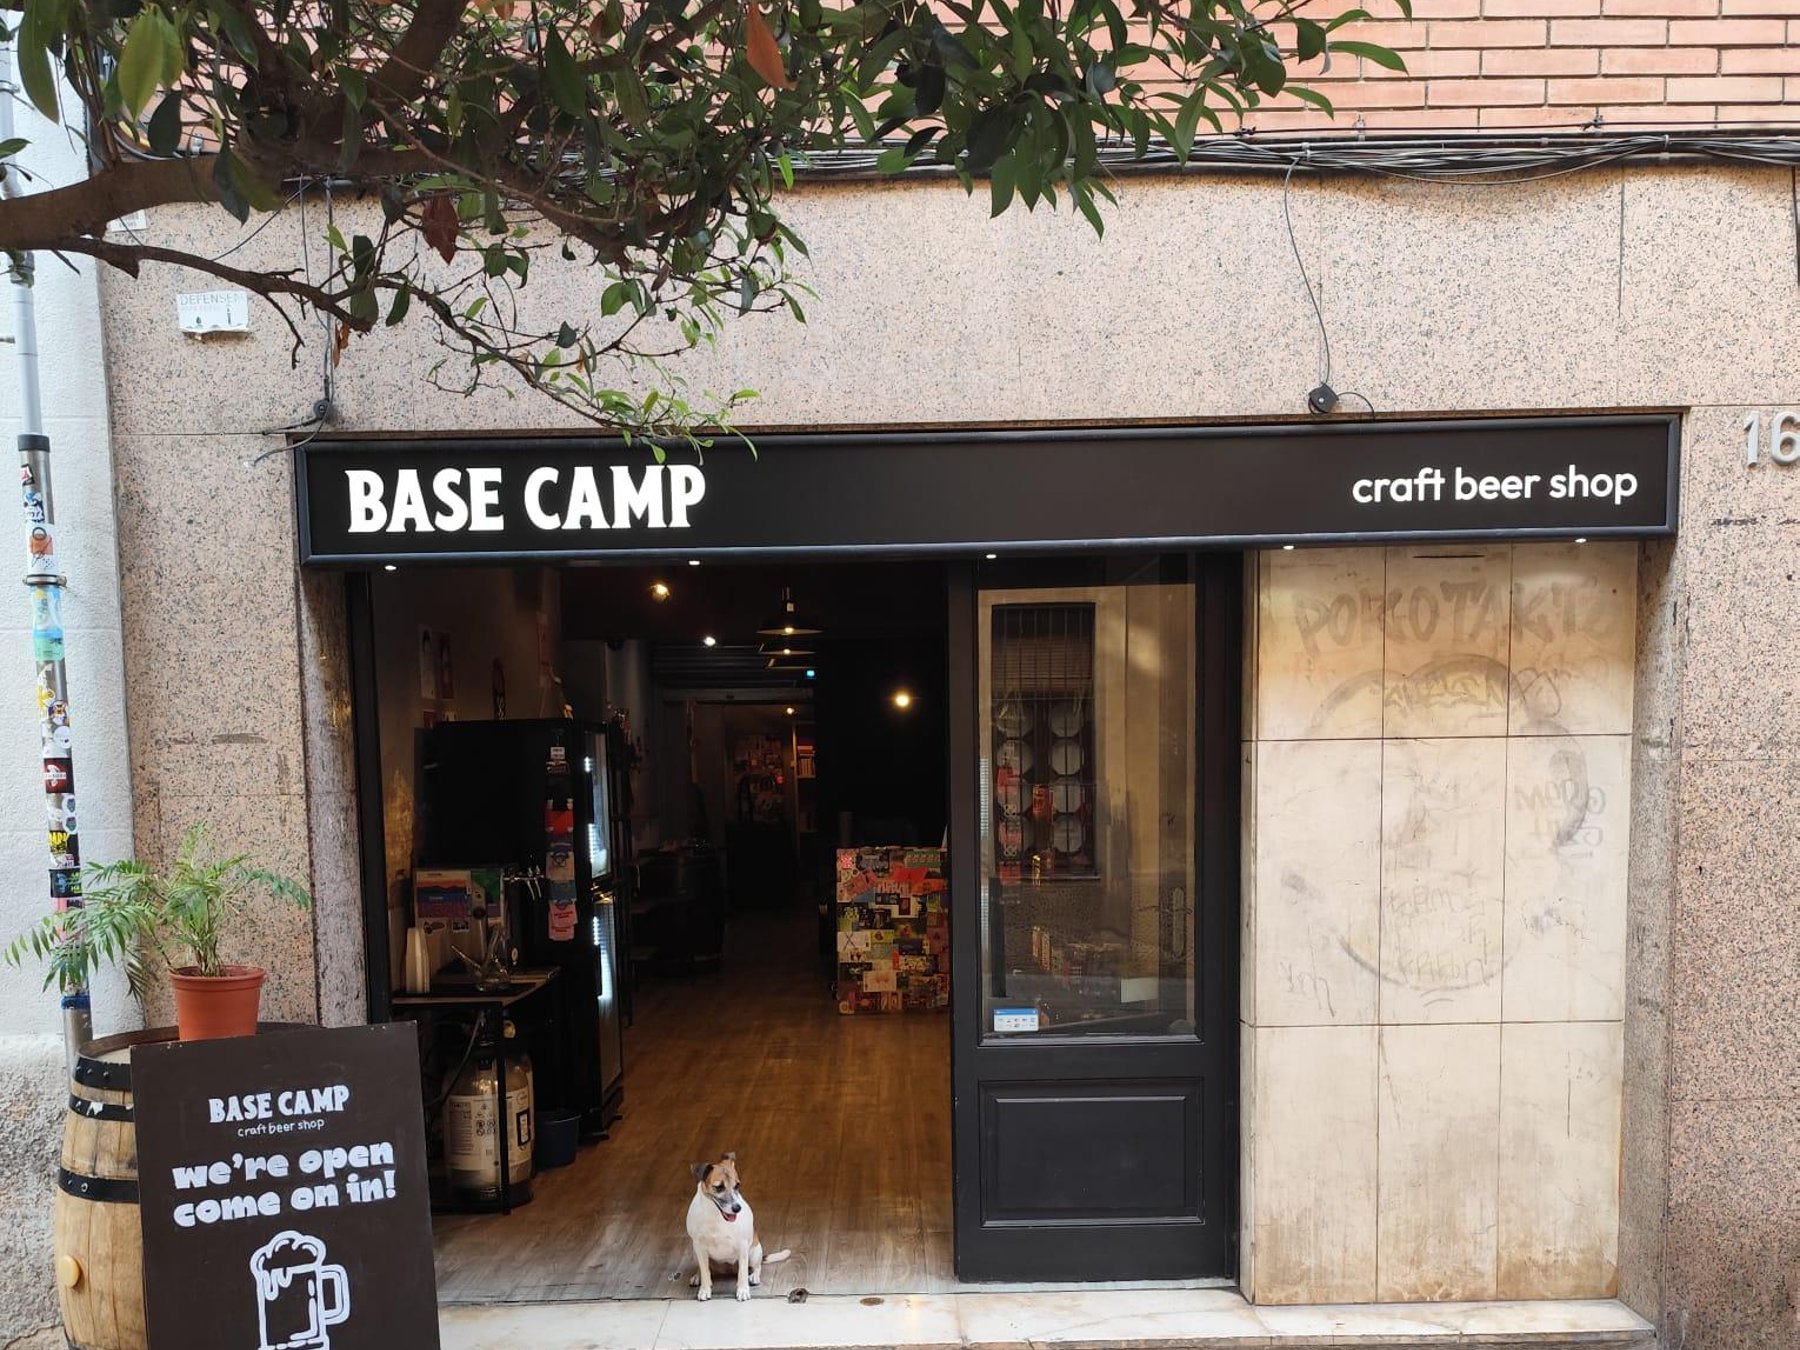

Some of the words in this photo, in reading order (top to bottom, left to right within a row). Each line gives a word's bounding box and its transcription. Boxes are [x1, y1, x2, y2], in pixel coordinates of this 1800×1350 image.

[1743, 410, 1800, 464] 16
[345, 468, 504, 533] BASE
[524, 464, 706, 530] CAMP
[1352, 467, 1445, 503] craft
[1455, 466, 1541, 501] beer
[1549, 464, 1638, 505] shop
[208, 1093, 273, 1123] BASE
[278, 1085, 350, 1116] CAMP
[237, 1123, 267, 1137] craft
[268, 1121, 296, 1135] beer
[297, 1118, 325, 1132] shop
[172, 1153, 289, 1189] we're
[299, 1141, 394, 1178] open
[173, 1191, 281, 1227] come
[290, 1183, 339, 1210] on
[346, 1169, 396, 1203] in!
